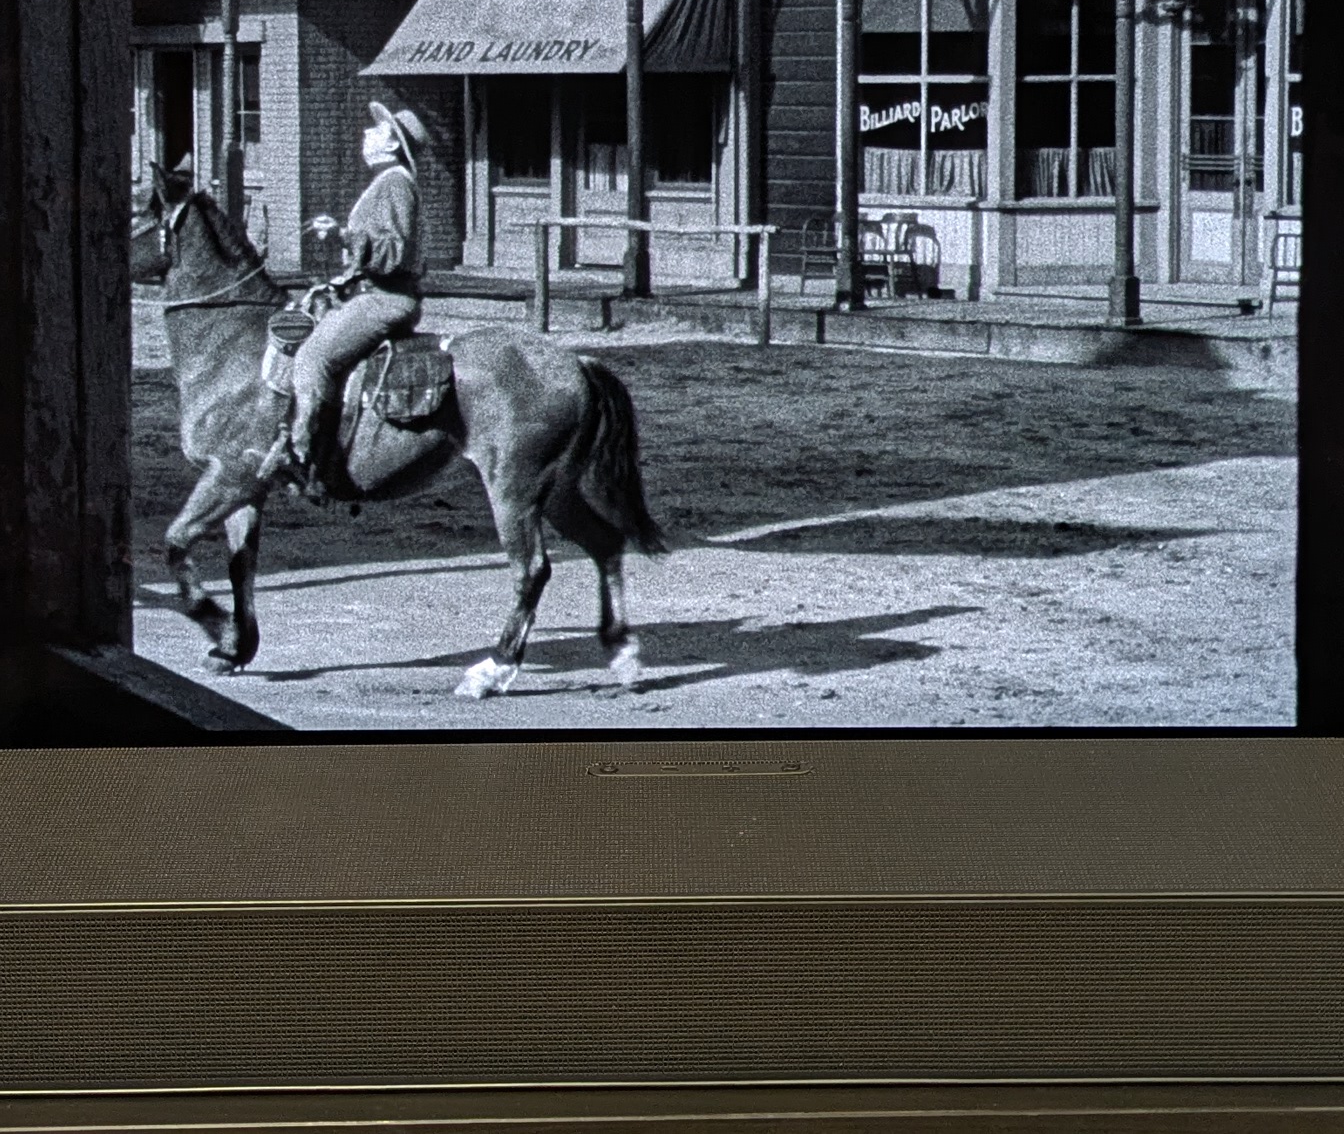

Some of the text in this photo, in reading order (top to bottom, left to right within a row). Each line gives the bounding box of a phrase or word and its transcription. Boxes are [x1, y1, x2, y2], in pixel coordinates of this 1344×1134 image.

[408, 38, 601, 63] HAND LAUNDRY
[859, 101, 921, 132] BILLIARD
